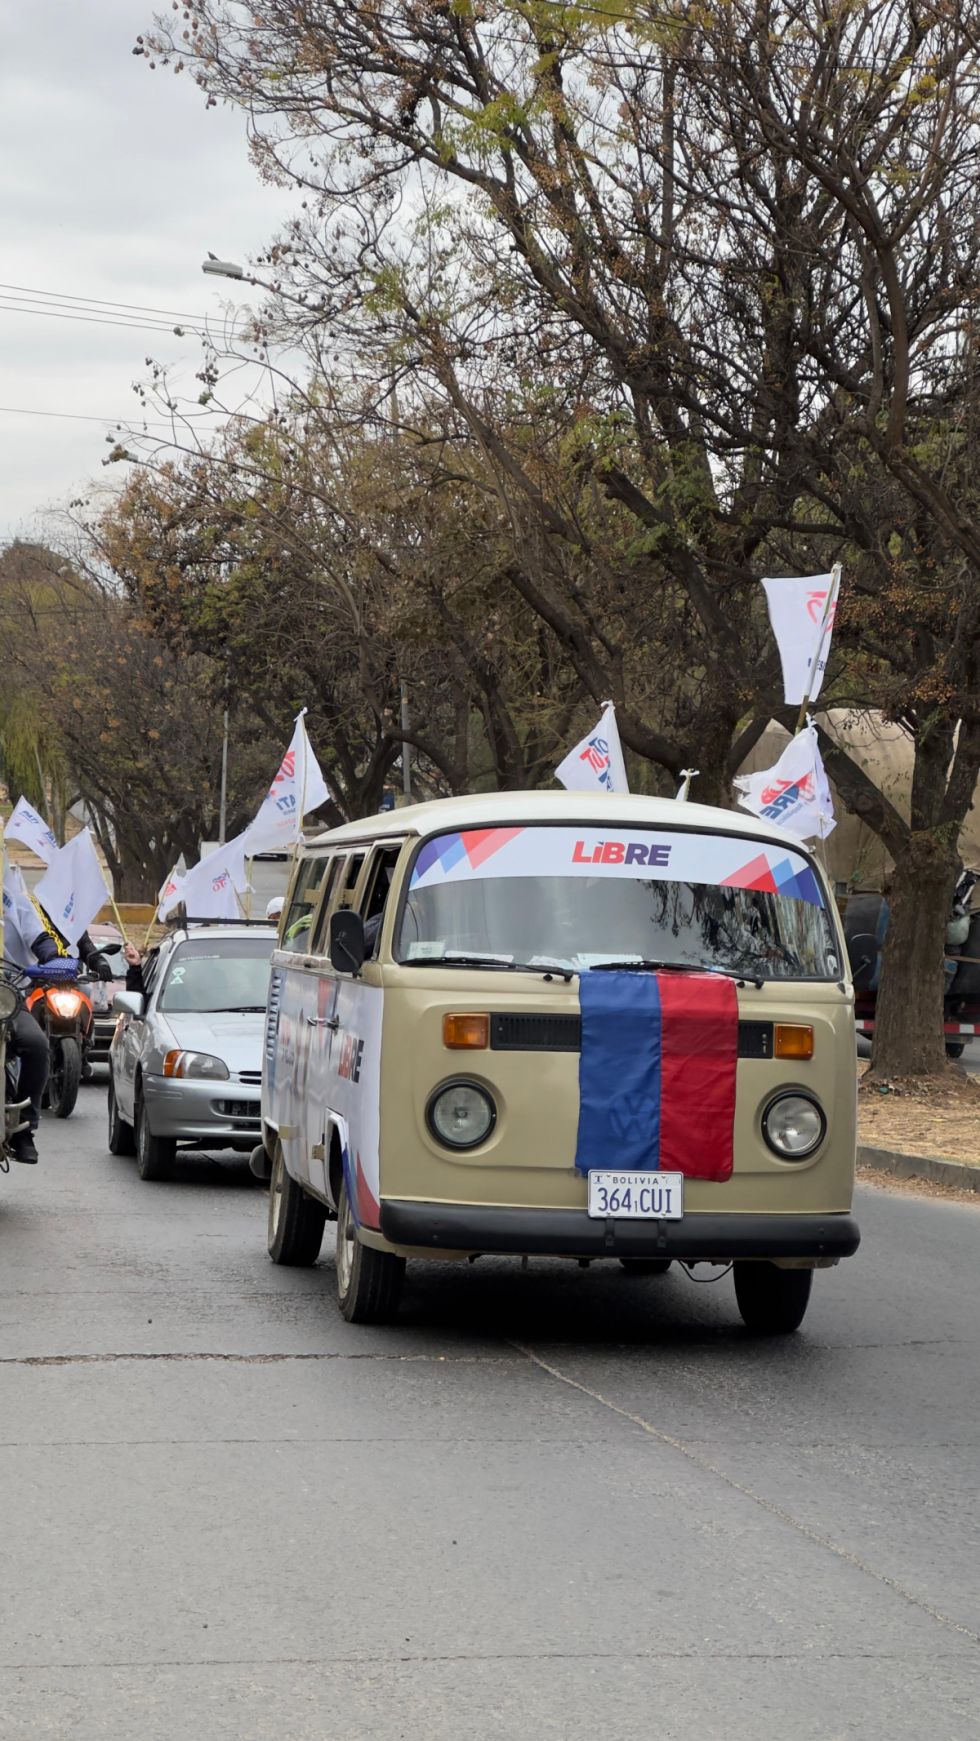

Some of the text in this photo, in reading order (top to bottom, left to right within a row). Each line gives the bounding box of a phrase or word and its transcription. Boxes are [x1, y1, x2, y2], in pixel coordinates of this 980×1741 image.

[612, 1176, 659, 1185] BOLIVIA
[597, 1187, 672, 1214] 364 CUI
